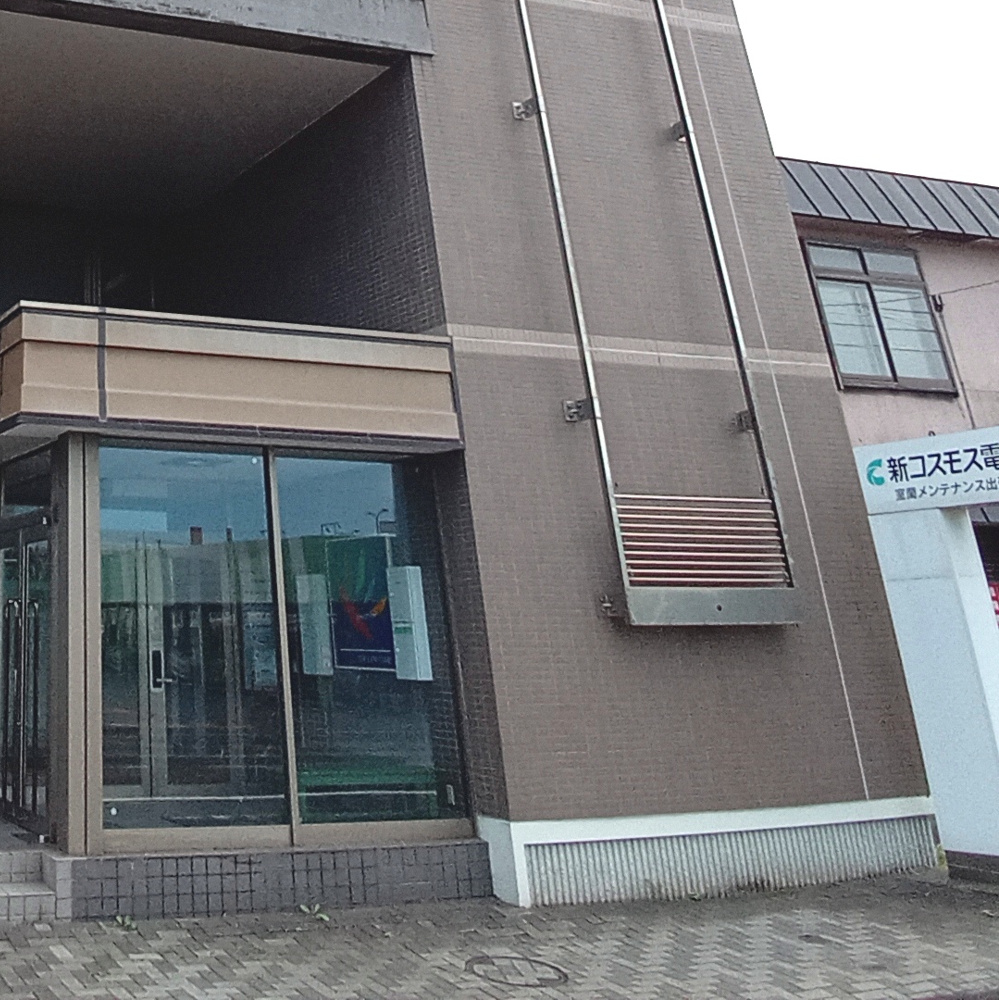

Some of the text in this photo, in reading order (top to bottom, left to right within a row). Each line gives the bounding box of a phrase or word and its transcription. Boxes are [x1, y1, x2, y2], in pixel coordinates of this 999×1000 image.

[895, 477, 999, 501] 室蘭メンテナンス出
